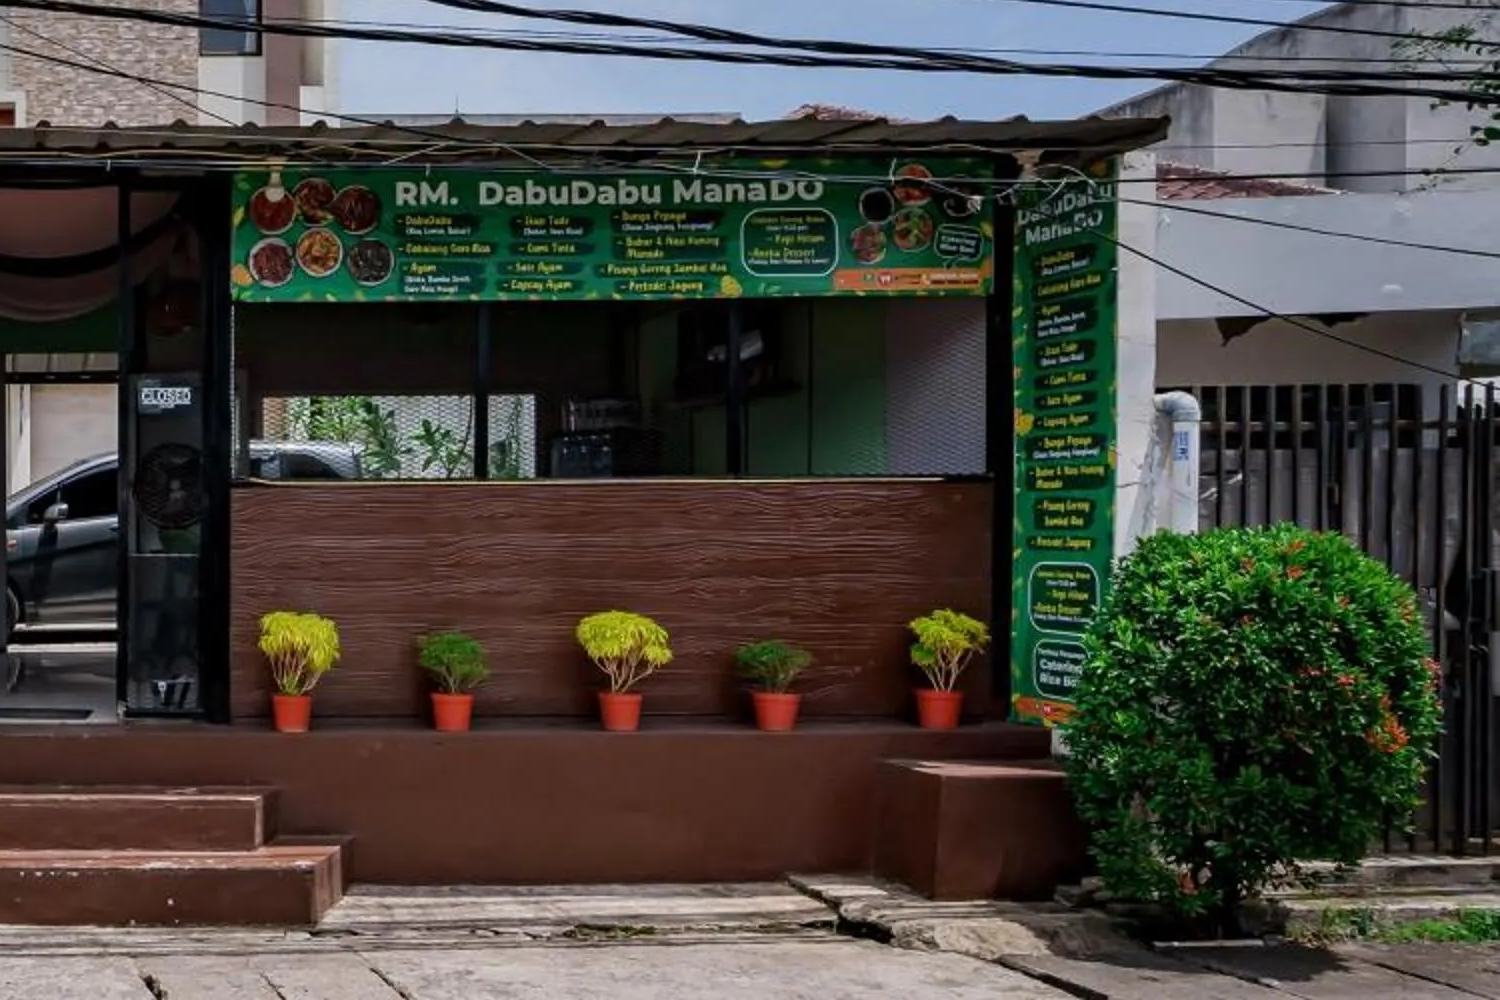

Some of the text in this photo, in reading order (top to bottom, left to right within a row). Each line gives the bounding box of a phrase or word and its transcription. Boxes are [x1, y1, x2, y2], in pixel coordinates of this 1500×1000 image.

[395, 178, 824, 206] RM. DabuDabu ManaDO
[1062, 674, 1078, 689] Bo
